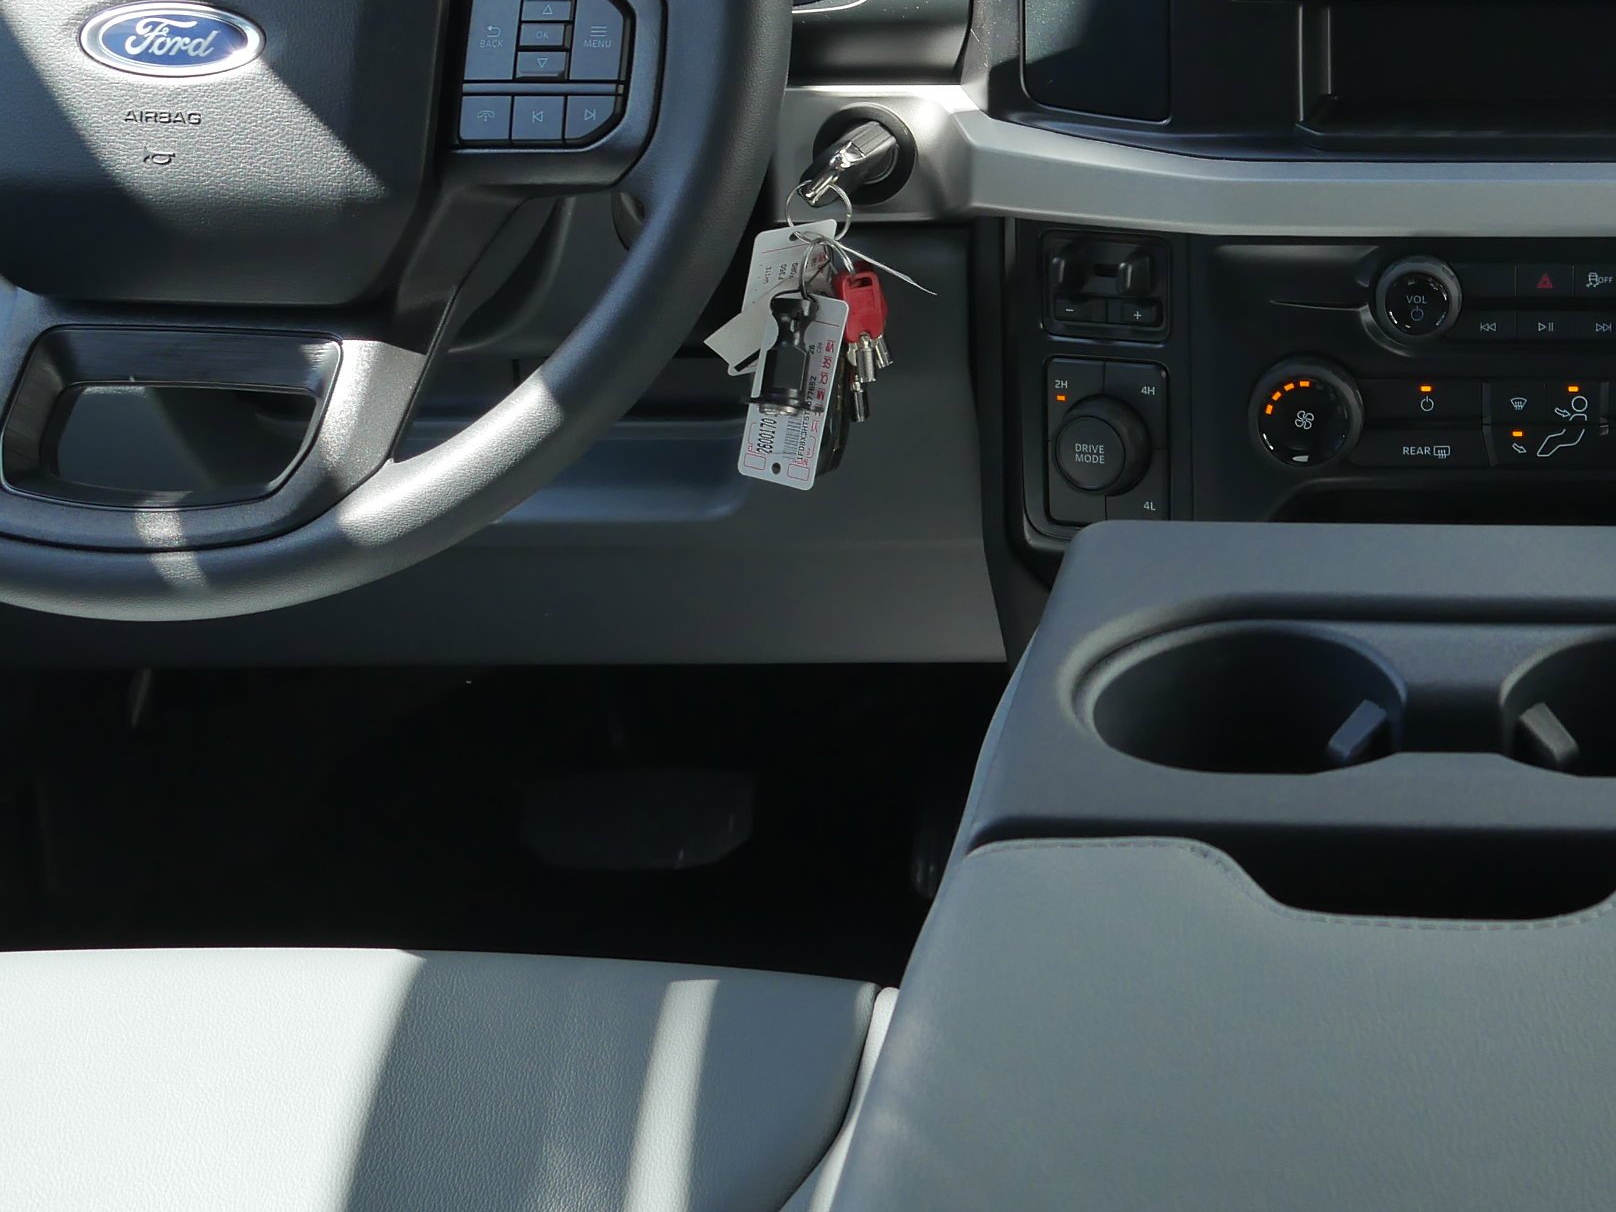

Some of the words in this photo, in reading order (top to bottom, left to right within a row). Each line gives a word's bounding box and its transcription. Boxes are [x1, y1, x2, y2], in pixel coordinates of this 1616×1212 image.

[124, 17, 221, 57] Ford
[536, 30, 549, 39] OK
[480, 39, 503, 48] BACK
[583, 39, 612, 48] MENU
[124, 110, 202, 125] AIRBAG
[1598, 276, 1614, 284] OFF
[1406, 295, 1427, 305] VOL
[1054, 379, 1068, 389] 2H
[1141, 386, 1156, 395] 4H
[1075, 443, 1105, 454] DRIVE
[1403, 445, 1431, 456] REAR
[1075, 453, 1105, 464] MODE
[1143, 501, 1157, 511] 4L
